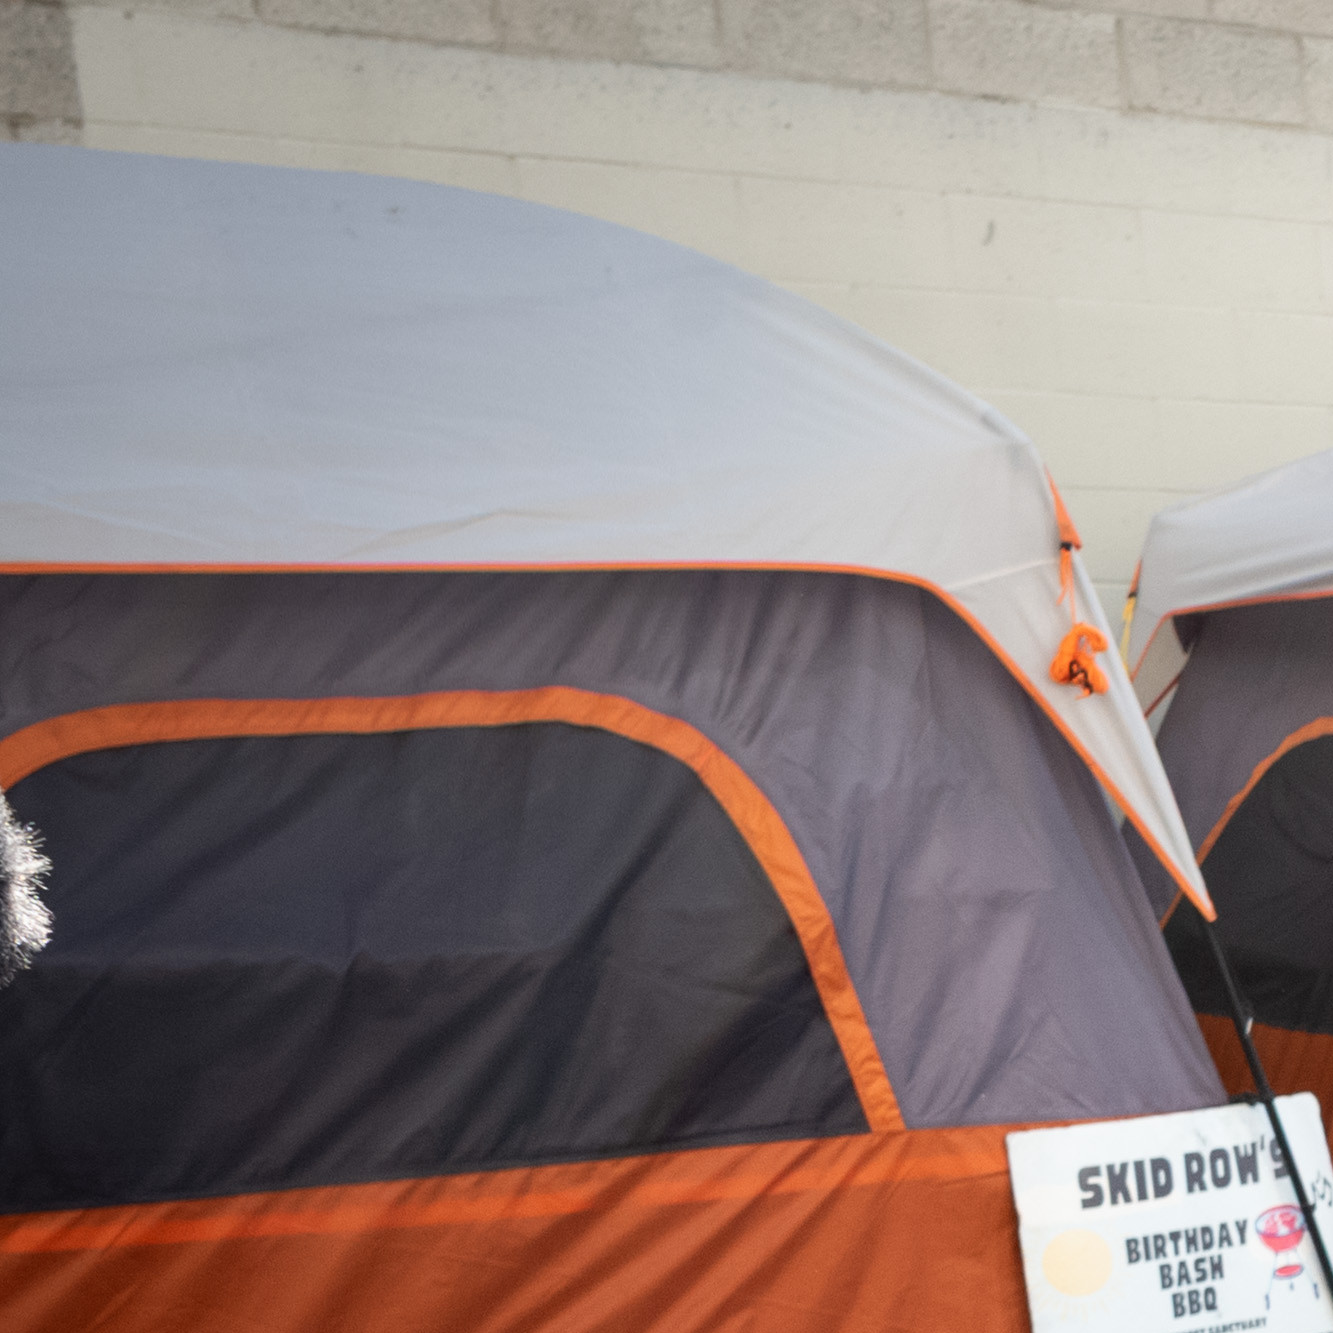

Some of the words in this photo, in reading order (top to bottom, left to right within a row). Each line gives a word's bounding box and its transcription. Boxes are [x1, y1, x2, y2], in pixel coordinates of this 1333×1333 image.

[1077, 1156, 1174, 1210] SKID
[1183, 1134, 1290, 1194] ROW'S
[1125, 1218, 1248, 1264] BIRTHDAY
[1158, 1253, 1225, 1290] BASH
[1171, 1286, 1219, 1319] BBQ
